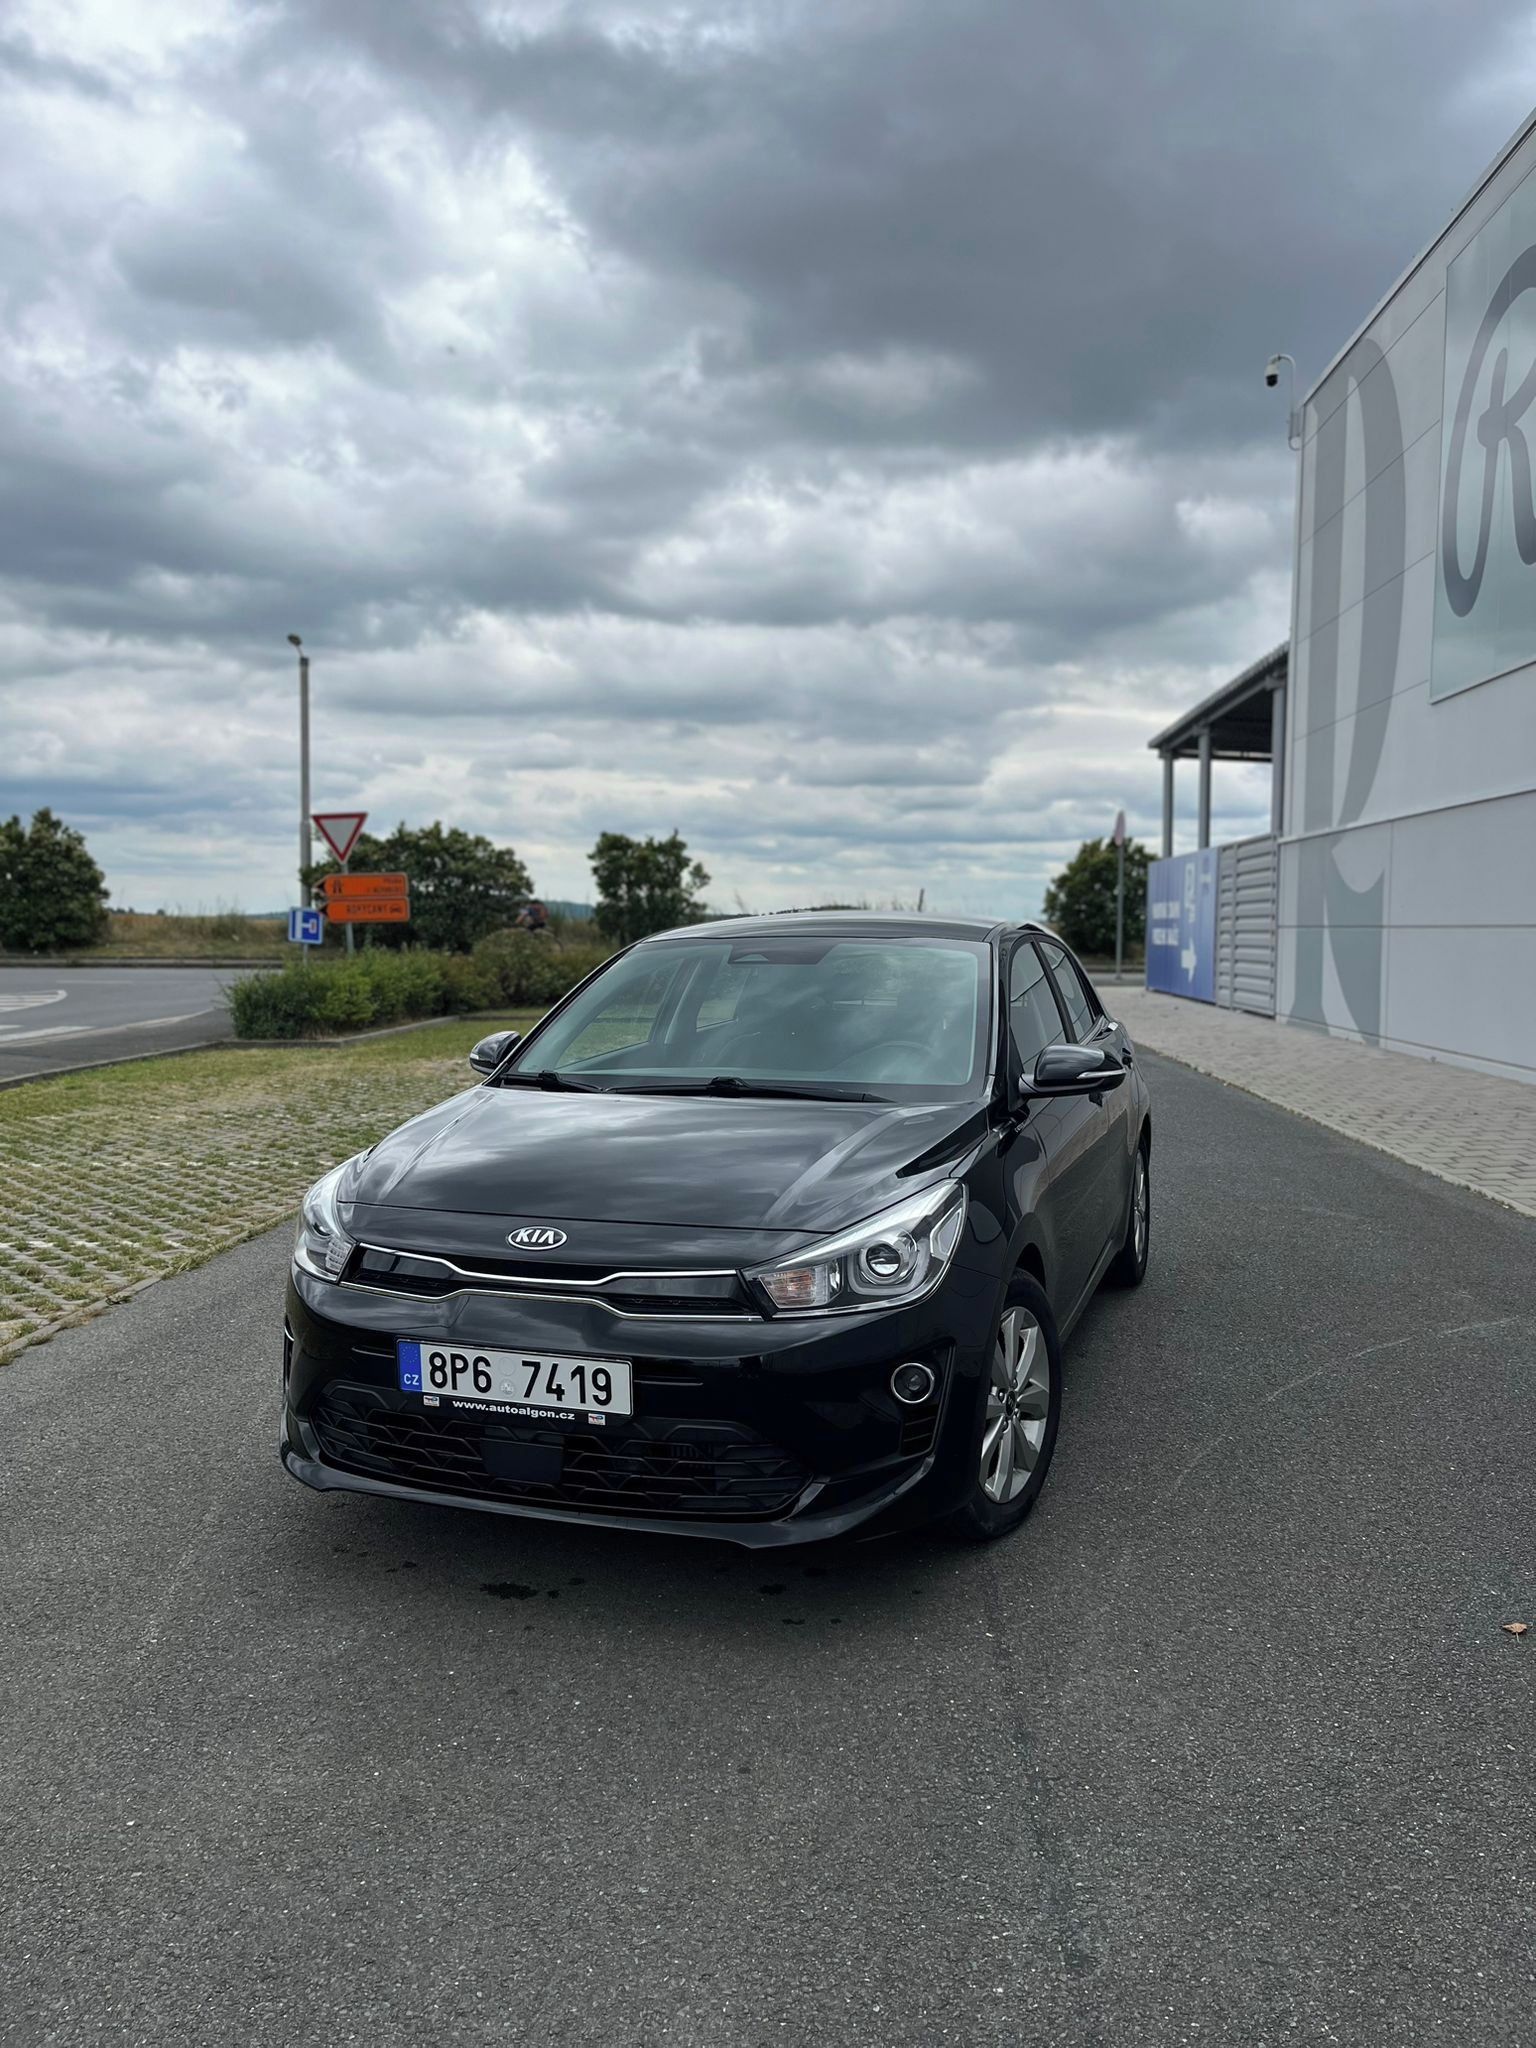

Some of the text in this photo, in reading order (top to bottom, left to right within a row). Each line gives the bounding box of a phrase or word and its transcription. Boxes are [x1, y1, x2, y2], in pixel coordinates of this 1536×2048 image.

[515, 1229, 555, 1245] KIA
[403, 1373, 420, 1386] CZ
[429, 1351, 612, 1406] 8P6 7419
[452, 1400, 576, 1420] www.autoalgon.cz
